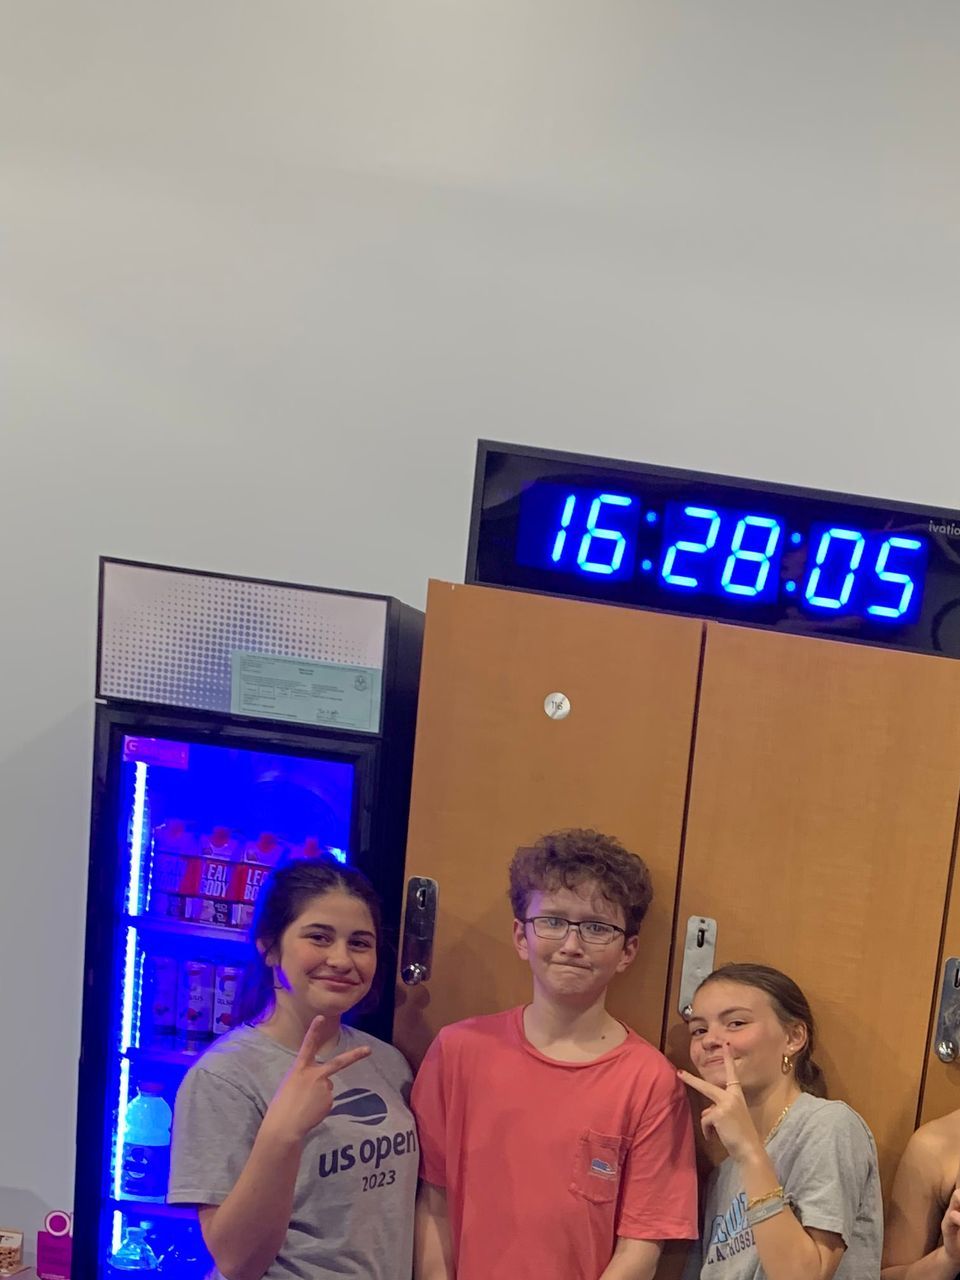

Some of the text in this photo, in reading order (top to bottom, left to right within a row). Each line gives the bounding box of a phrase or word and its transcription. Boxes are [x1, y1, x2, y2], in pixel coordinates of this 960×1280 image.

[552, 493, 921, 618] 16:28:05
[318, 1130, 416, 1178] us open
[362, 1169, 396, 1192] 2023
